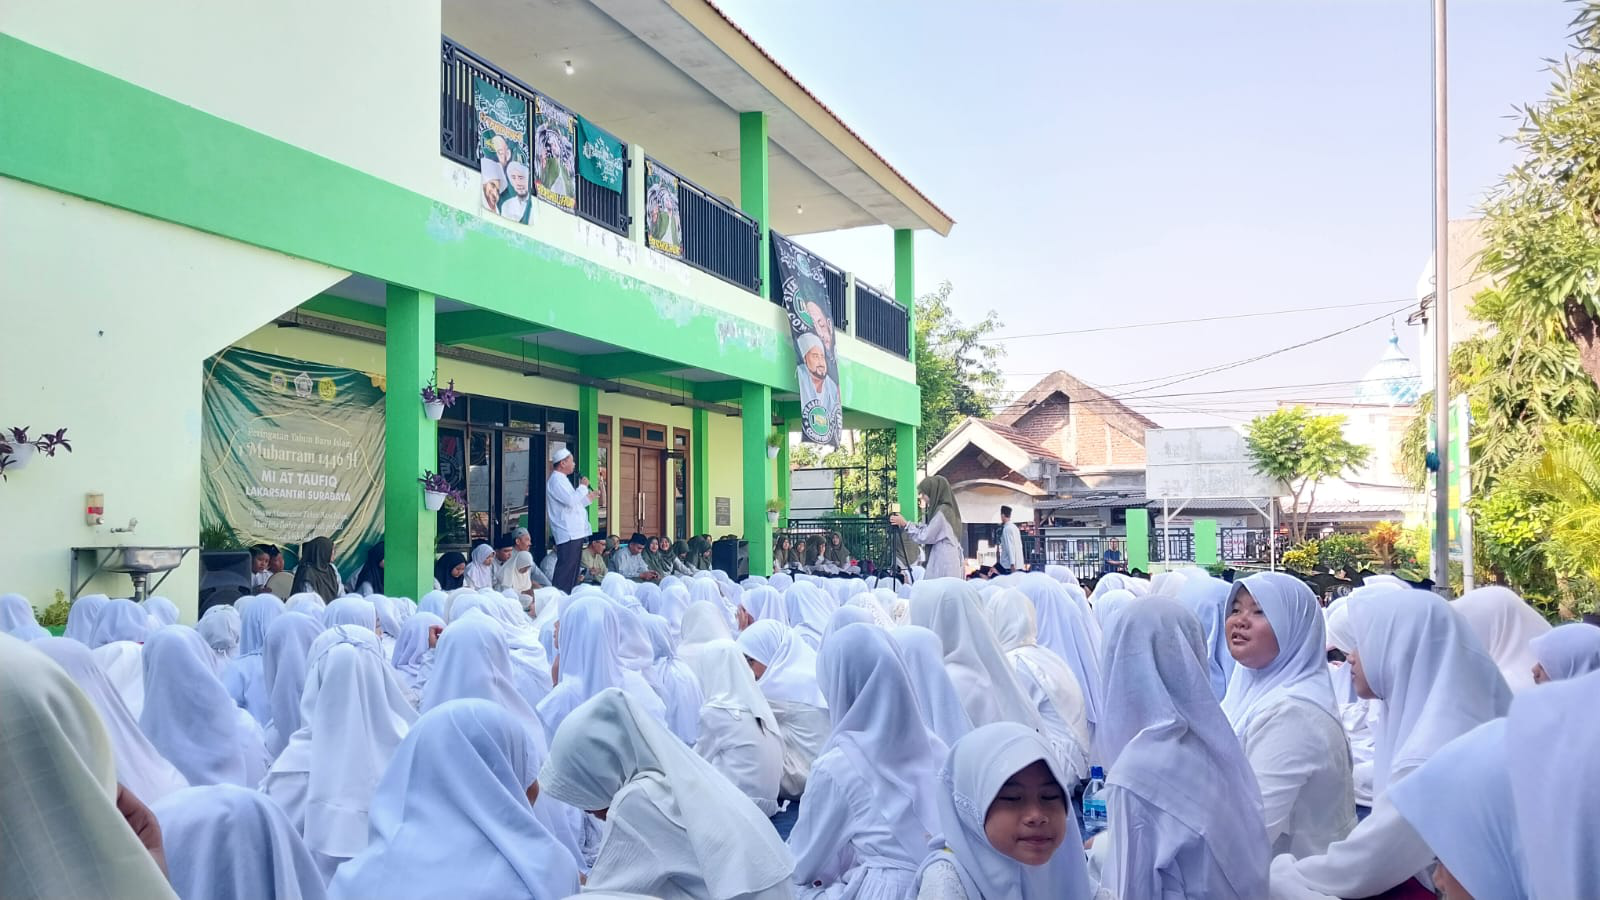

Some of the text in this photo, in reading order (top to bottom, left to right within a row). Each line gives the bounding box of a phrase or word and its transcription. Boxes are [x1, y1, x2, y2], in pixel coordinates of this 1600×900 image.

[248, 429, 353, 448] Peringatan Tahun Baru Islam
[247, 442, 315, 465] Muharram
[318, 453, 344, 469] 1446
[261, 470, 337, 488] MI AT TAUFIQ
[246, 486, 351, 502] LAKARSANTRI SURABAYA
